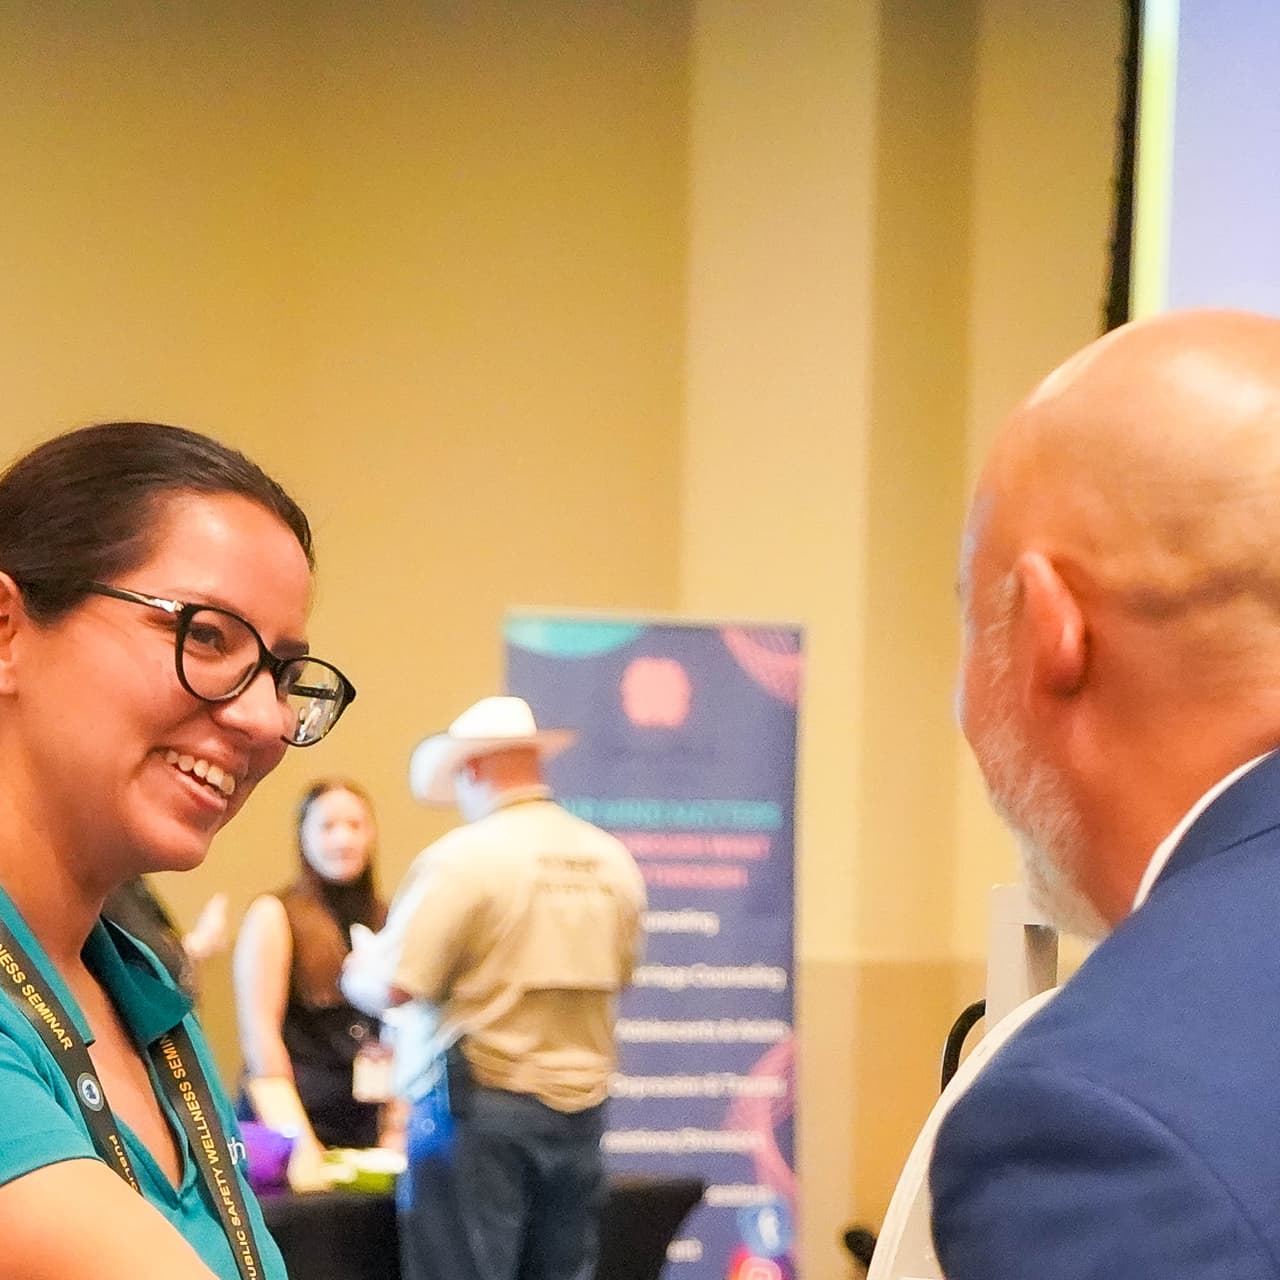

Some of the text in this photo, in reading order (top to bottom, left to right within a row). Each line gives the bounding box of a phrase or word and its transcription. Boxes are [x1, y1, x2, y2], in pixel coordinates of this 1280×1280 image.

[22, 984, 73, 1050] SEMINAR
[160, 1033, 188, 1079] SEMIN
[179, 1080, 220, 1165] WELLNESS
[212, 1167, 242, 1227] SAFETY
